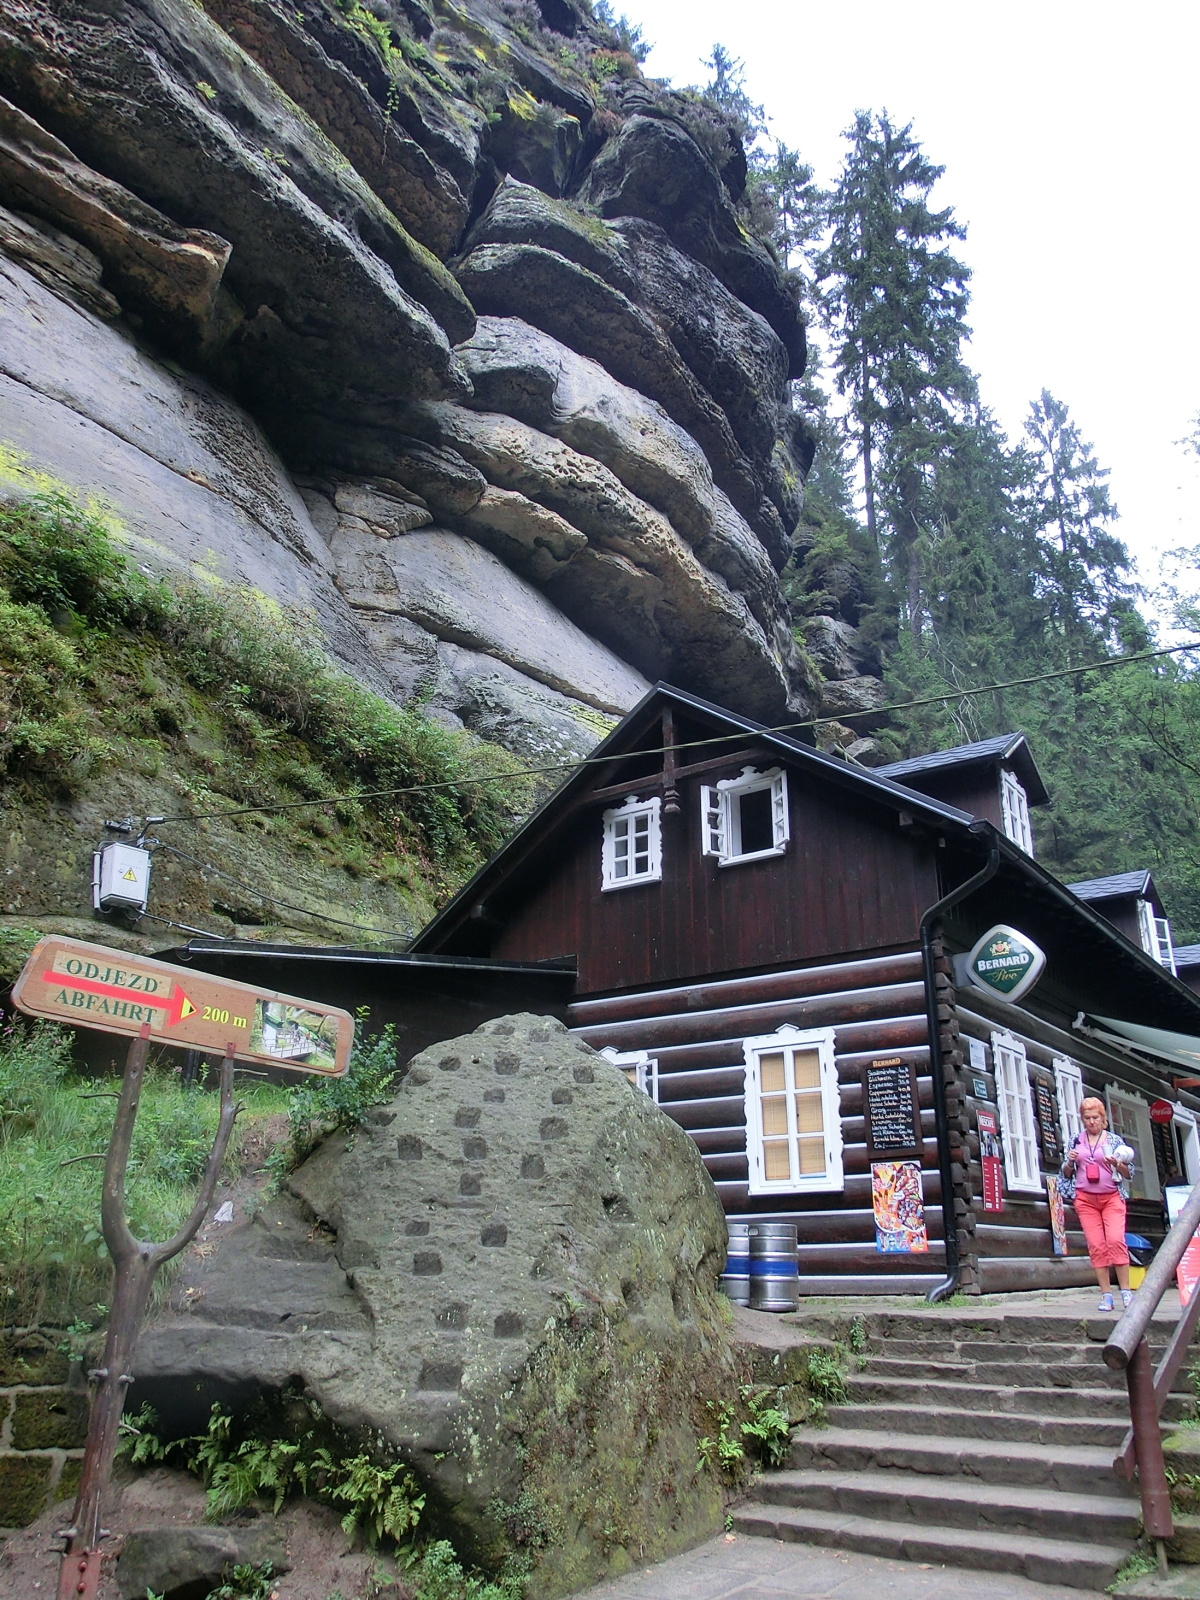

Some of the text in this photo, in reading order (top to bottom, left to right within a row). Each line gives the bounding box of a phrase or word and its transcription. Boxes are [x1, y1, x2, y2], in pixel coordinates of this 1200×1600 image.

[978, 953, 1030, 971] BERNARD
[66, 959, 158, 993] ODJEZD
[992, 968, 1018, 983] Pivo
[54, 988, 157, 1023] ABFAHRT
[202, 1005, 248, 1029] 200 m
[872, 1057, 901, 1068] BERNARD
[1151, 1107, 1172, 1116] Coca-Cola
